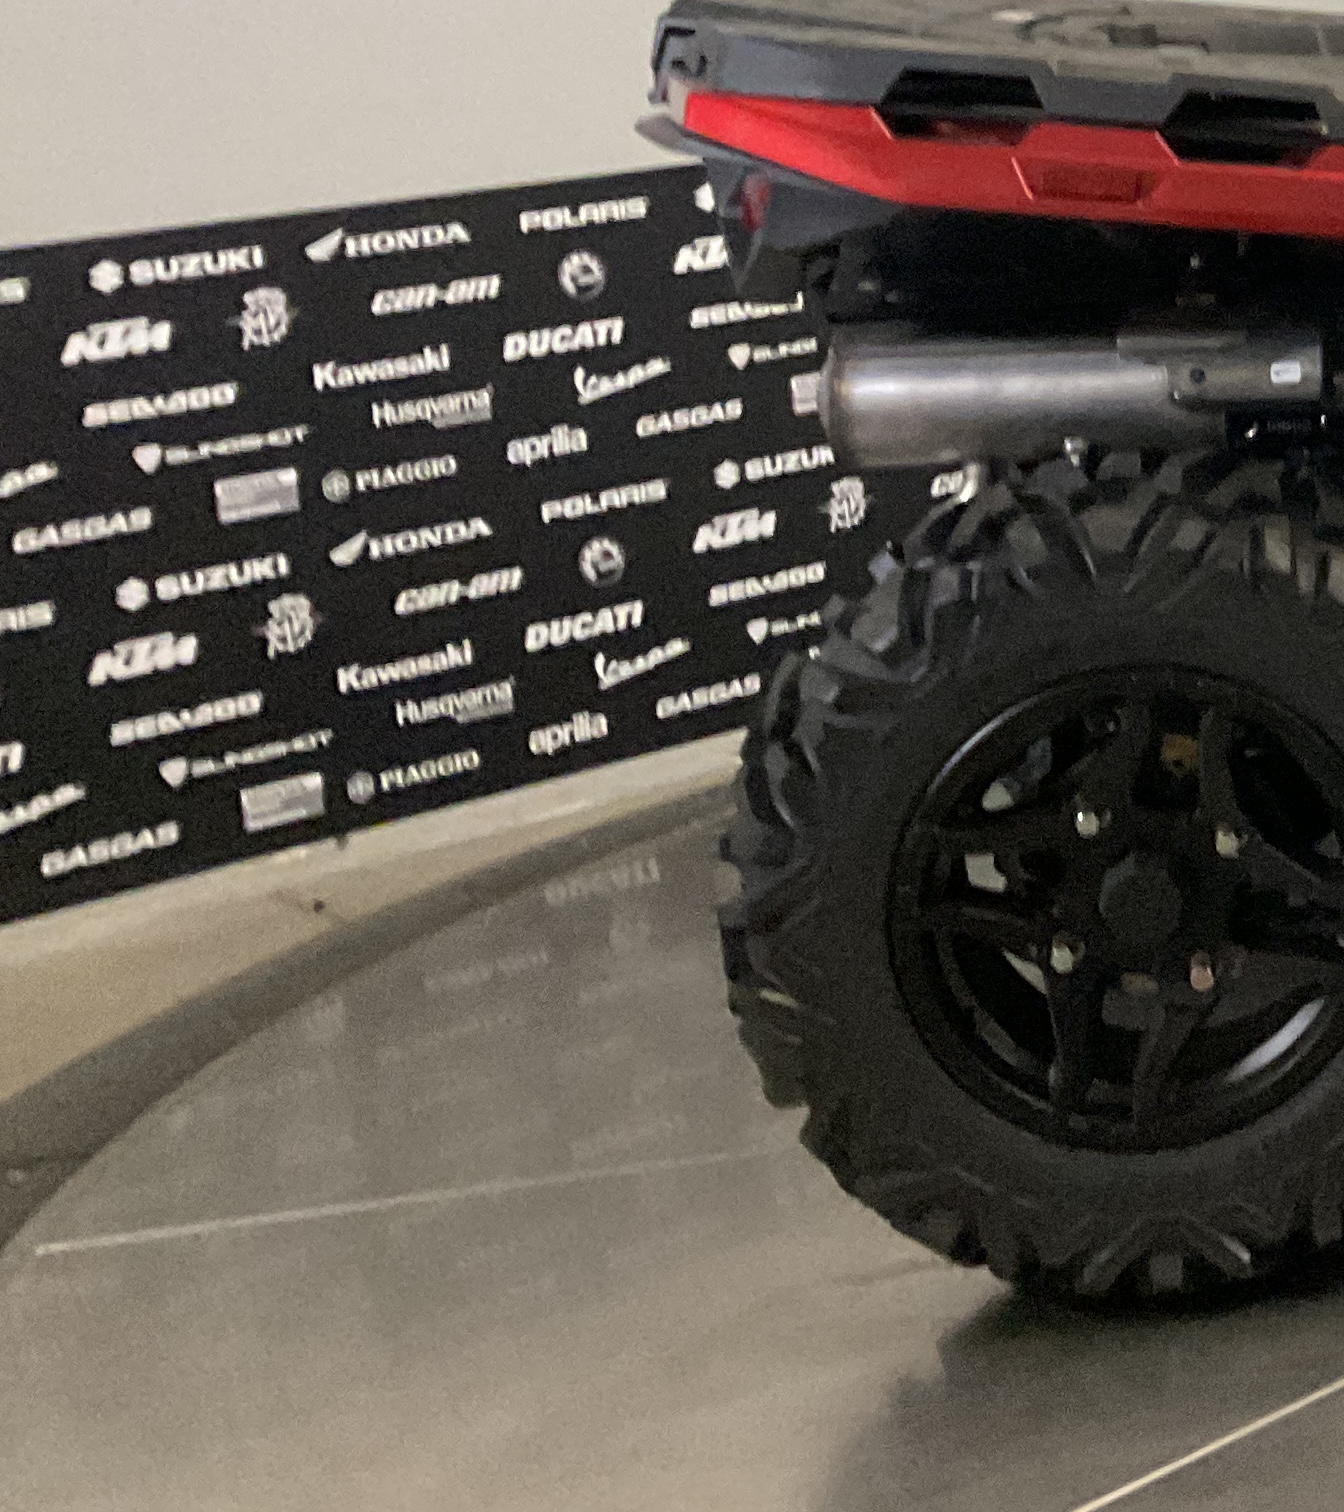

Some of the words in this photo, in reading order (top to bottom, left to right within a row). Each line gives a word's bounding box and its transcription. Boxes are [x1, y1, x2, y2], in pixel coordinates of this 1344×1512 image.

[518, 195, 649, 235] POLARIS
[345, 221, 472, 258] HONDA
[128, 244, 265, 286] SUZUKI
[370, 273, 502, 316] can-am
[60, 315, 173, 367] KTM
[502, 315, 625, 363] DUCATI
[312, 343, 452, 392] Kawasaki
[635, 398, 743, 438] GASGAS
[506, 423, 588, 468] aprilia
[743, 445, 836, 482] SUZUK
[355, 454, 458, 492] PIAGGIO
[540, 478, 668, 524] POLARIS
[12, 506, 153, 554] GASGAS
[368, 516, 493, 560] HONDA
[692, 507, 777, 554] KTM
[154, 552, 290, 601] SUZUKI
[394, 565, 524, 615] can-am
[524, 599, 644, 653] DUCATI
[87, 631, 199, 687] KTM
[336, 638, 474, 694] Kawasaki
[655, 673, 761, 719] GASGAS
[528, 710, 609, 756] aprilia
[379, 749, 481, 792] PIAGGIO
[40, 821, 180, 878] GASGAS
